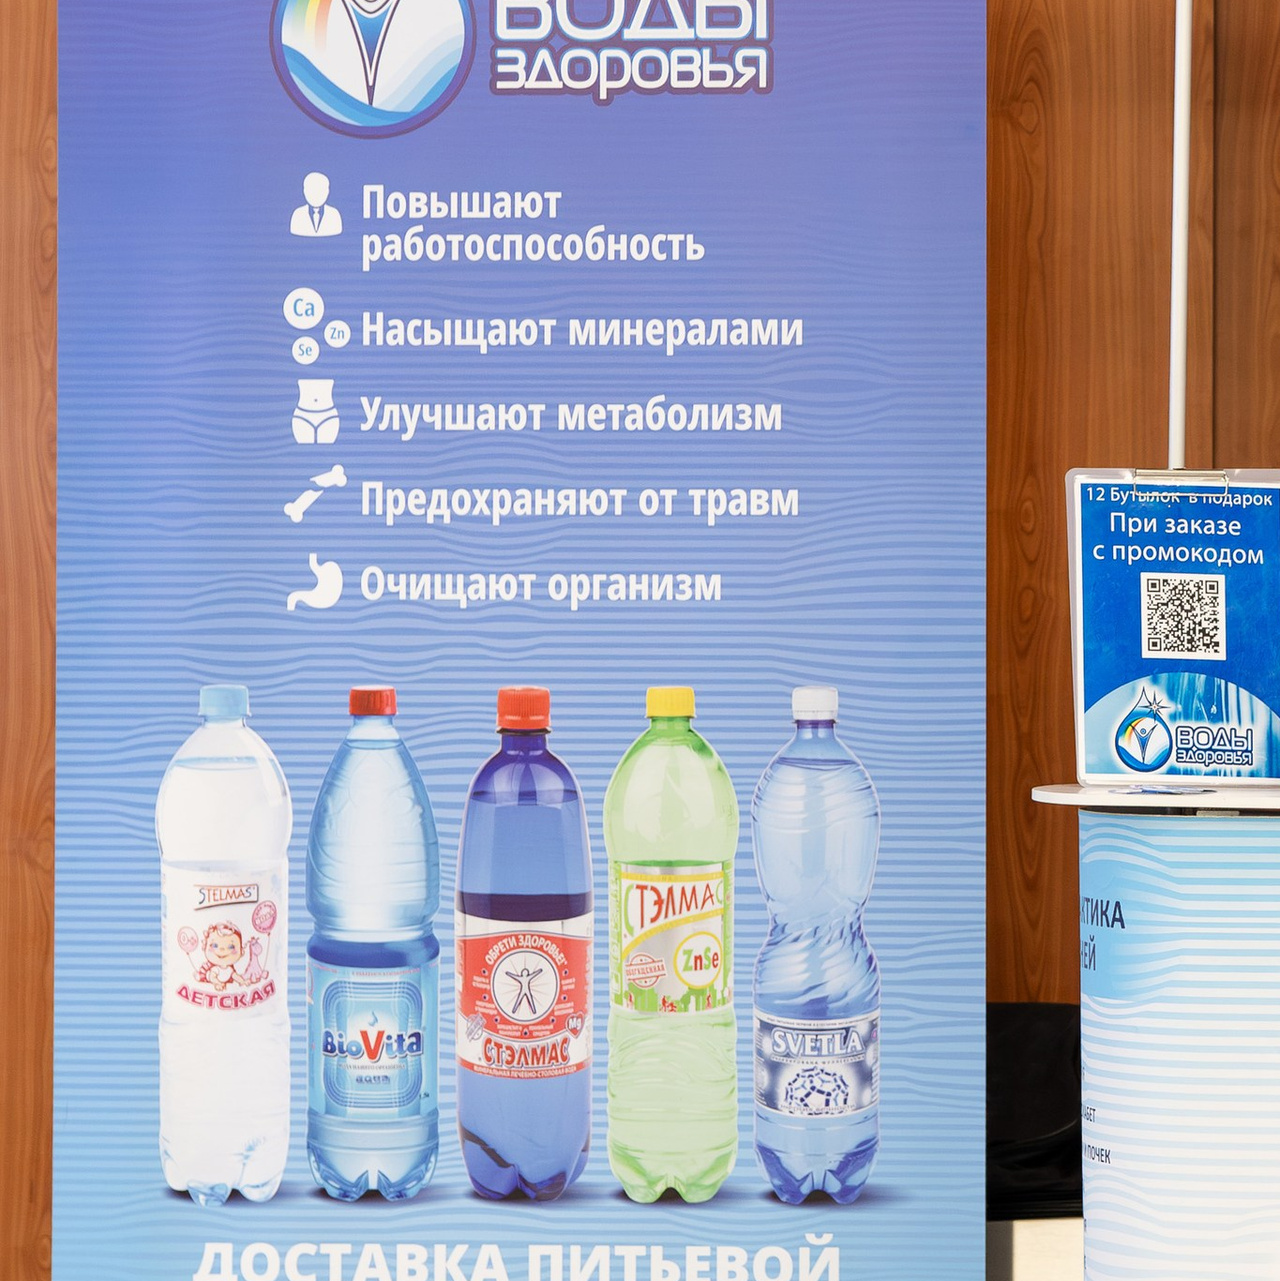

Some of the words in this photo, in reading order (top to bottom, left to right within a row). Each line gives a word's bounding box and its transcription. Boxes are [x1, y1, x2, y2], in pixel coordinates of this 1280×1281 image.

[362, 184, 561, 219] Повышают
[362, 224, 705, 271] работоспособность
[292, 298, 315, 318] Ca
[330, 327, 345, 339] Zn
[362, 311, 556, 354] Насыщают
[568, 317, 803, 355] минералами
[298, 344, 312, 356] Se
[361, 396, 546, 441] Улучшают
[558, 394, 782, 431] метаболизм
[362, 481, 627, 526] Предохраняют
[639, 487, 676, 516] от
[689, 488, 799, 526] травм
[1087, 487, 1105, 501] 12
[1110, 488, 1180, 505] Бутылок
[1203, 492, 1272, 508] подарок
[1110, 512, 1157, 535] При
[1165, 518, 1241, 535] заказе
[1093, 545, 1105, 560] с
[1113, 545, 1263, 567] промокодом
[361, 566, 536, 609] Очищают
[548, 573, 722, 611] организм
[1176, 726, 1252, 750] ВОДЫ
[199, 887, 252, 904] STELMAS
[624, 880, 722, 937] СТЭЛМАС
[485, 936, 516, 965] ОБРЕТИ
[682, 946, 719, 972] ZnSe
[177, 980, 275, 1009] ДЕТСКАЯ
[322, 1030, 423, 1061] BioVita
[483, 1037, 570, 1068] СТЭЛМАС
[773, 1029, 863, 1055] SVETLA
[1087, 1144, 1111, 1164] ПОЧЕК
